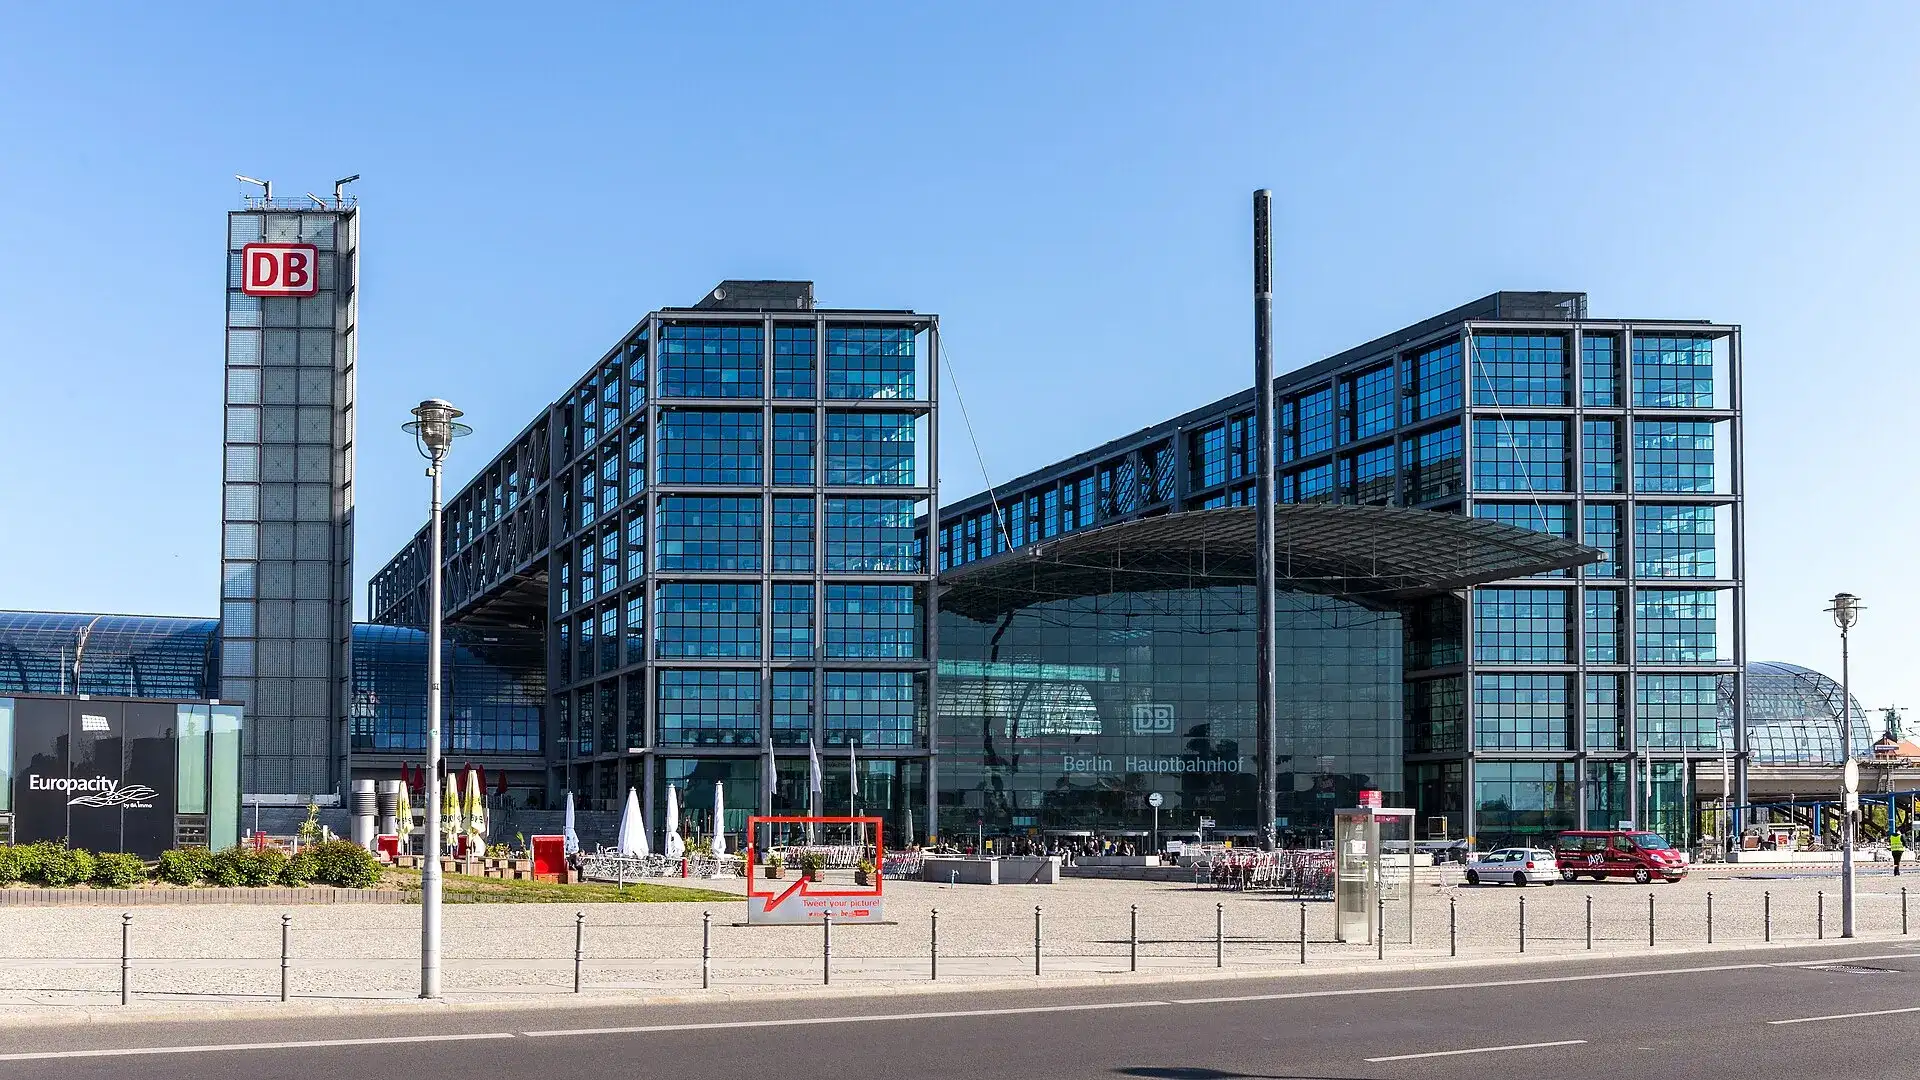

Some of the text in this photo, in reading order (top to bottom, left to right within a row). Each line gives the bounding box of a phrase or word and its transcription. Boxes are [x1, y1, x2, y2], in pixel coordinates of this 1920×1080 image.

[252, 252, 308, 287] DB
[1138, 707, 1169, 729] DB
[1063, 756, 1244, 774] Berlin Hauptbahnhof
[29, 774, 119, 796] Europacity
[850, 899, 880, 908] picture!
